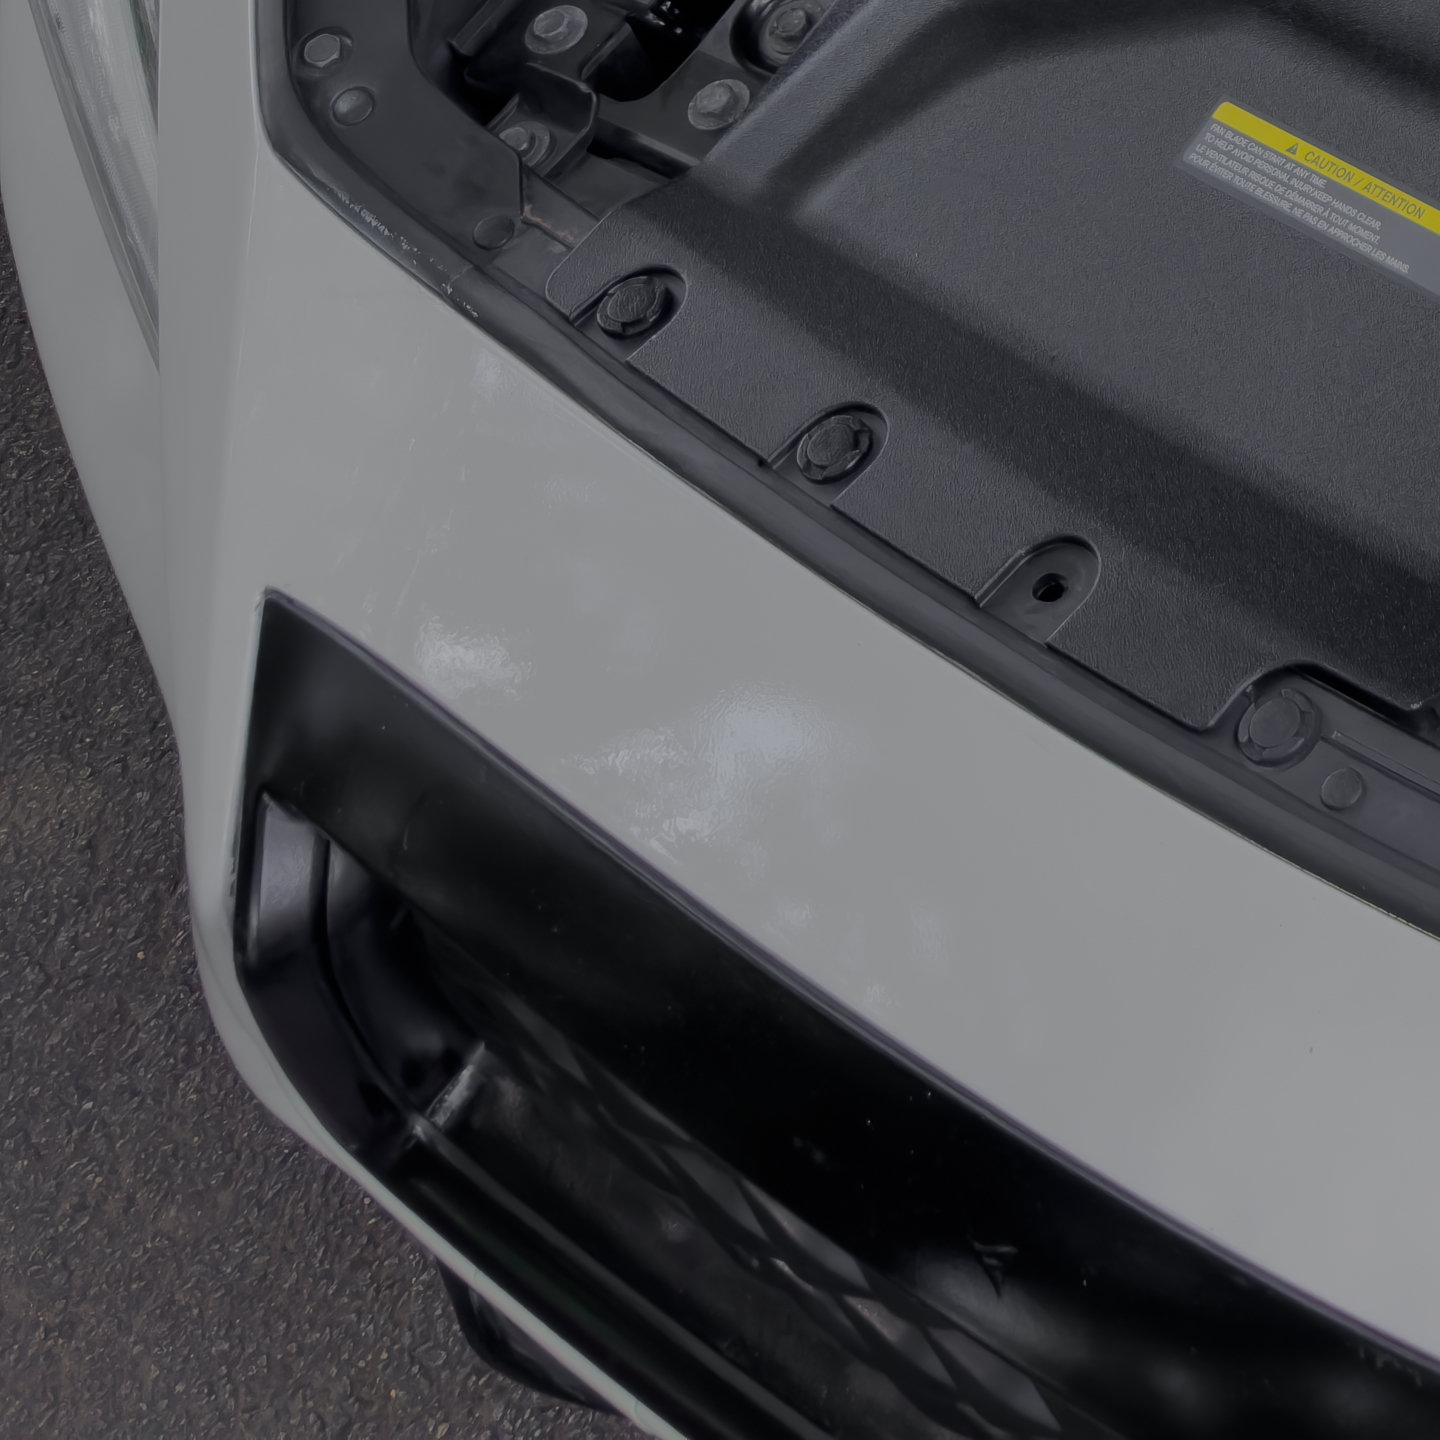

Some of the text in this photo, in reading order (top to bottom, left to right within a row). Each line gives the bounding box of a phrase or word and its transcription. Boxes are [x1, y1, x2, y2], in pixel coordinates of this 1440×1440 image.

[1195, 144, 1206, 152] LE
[1205, 148, 1249, 175] VENTILATEUR
[1247, 171, 1275, 188] RISQUE
[1274, 184, 1286, 194] DE
[1284, 188, 1324, 213] DÉMARRER
[1329, 213, 1349, 226] TOUT
[1204, 133, 1215, 142] TO
[1214, 138, 1233, 151] HELP
[1231, 147, 1254, 162] AVOID
[1252, 158, 1290, 181] PERSONAL
[1331, 199, 1357, 216] HANDS
[1210, 123, 1226, 134] FAN
[1224, 130, 1249, 146] BLADE
[1247, 142, 1263, 154] CAN
[1262, 150, 1285, 165] START
[1284, 162, 1294, 170] AT
[1292, 166, 1310, 178] ANY
[1304, 150, 1357, 184] CAUTION
[1362, 181, 1427, 220] ATTENTION
[1188, 152, 1211, 168] POUR
[1209, 162, 1234, 179] ÉVITER
[1232, 175, 1256, 191] TOUTE
[1291, 207, 1304, 216] NE
[1302, 212, 1318, 224] PAS
[1316, 220, 1328, 229] EN
[1326, 224, 1372, 253] APPROCHER
[1370, 248, 1386, 260] LES
